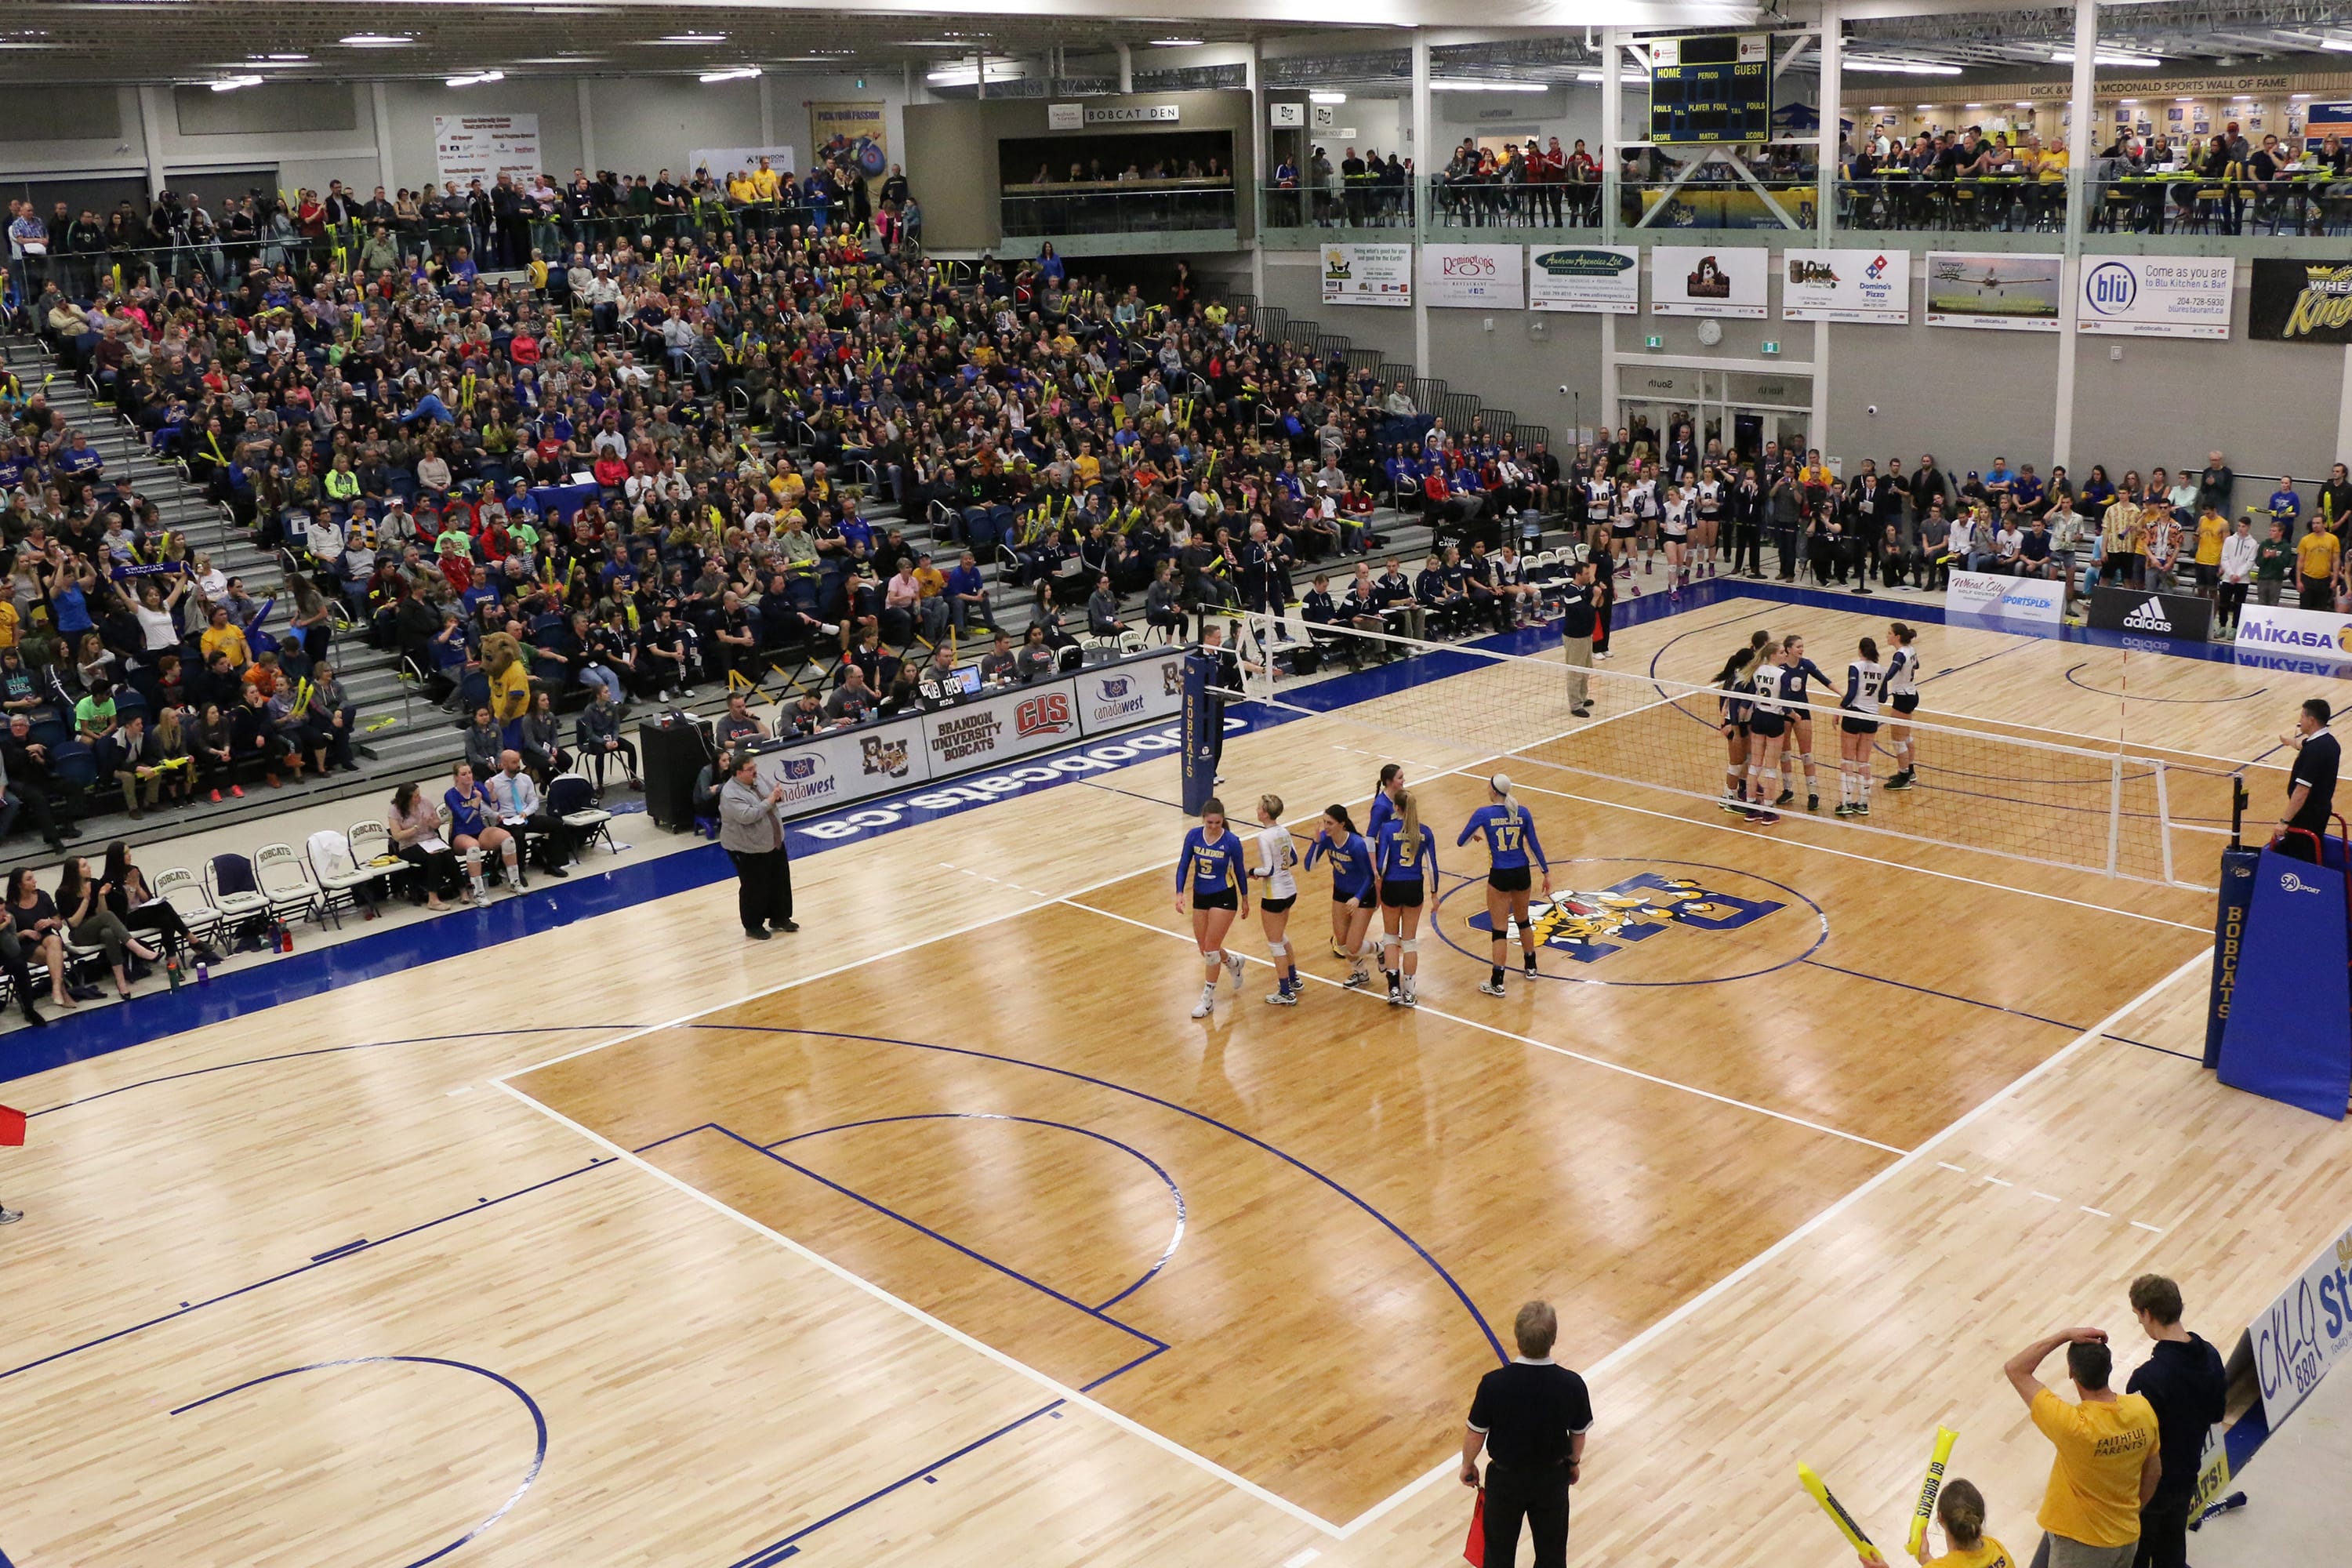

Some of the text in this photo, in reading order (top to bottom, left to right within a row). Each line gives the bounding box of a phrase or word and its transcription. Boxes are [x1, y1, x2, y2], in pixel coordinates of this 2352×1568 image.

[1657, 67, 1681, 78] HOME
[1734, 64, 1762, 75] GUEST
[2031, 86, 2054, 96] DICK
[2101, 82, 2161, 93] MCDONALD
[2164, 81, 2204, 91] SPORTS
[2206, 80, 2234, 89] WALL
[2238, 79, 2254, 89] OF
[2256, 78, 2287, 88] FAME
[853, 111, 880, 121] PASSION
[1088, 108, 1141, 120] BOBCAT
[1150, 108, 1176, 118] DEN
[1544, 254, 1624, 267] Andrew Agencies Ltd.
[2145, 265, 2227, 281] Come as you are
[2170, 279, 2200, 288] Kitchen
[2176, 297, 2224, 307] 204-728-5930
[1596, 492, 1608, 502] 10
[1673, 514, 1681, 524] 4
[1443, 535, 1461, 544] Volley
[1952, 577, 2006, 597] Wheat City
[2123, 615, 2172, 632] adidas
[2239, 621, 2333, 649] MIKASA
[1756, 675, 1775, 685] TWU
[1864, 671, 1882, 681] TWU
[1865, 684, 1878, 696] 7
[1014, 693, 1070, 735] CIS
[1094, 695, 1144, 721] canadawest
[938, 711, 993, 736] BRANDON
[931, 721, 1002, 751] UNIVERSITY
[944, 738, 994, 762] BOBCATS
[782, 775, 836, 801] nadawest
[1490, 817, 1523, 826] BOBCTS
[351, 823, 383, 838] BOBCATS
[1496, 826, 1521, 851] 17
[259, 847, 292, 862] BOBCATS
[1193, 845, 1225, 858] BRANDON
[1280, 845, 1291, 870] 3
[1200, 858, 1214, 874] 5
[158, 870, 191, 887] BOBCATS
[2299, 884, 2321, 895] SPORT
[2217, 906, 2243, 1019] BOBCATS
[2319, 1265, 2352, 1339] St
[2259, 1276, 2322, 1400] CKLQ
[2296, 1350, 2318, 1394] 880
[2096, 1427, 2147, 1449] FAITHFUL
[2093, 1439, 2147, 1458] PARENTS!
[1916, 1461, 1945, 1519] GO BOBCATS
